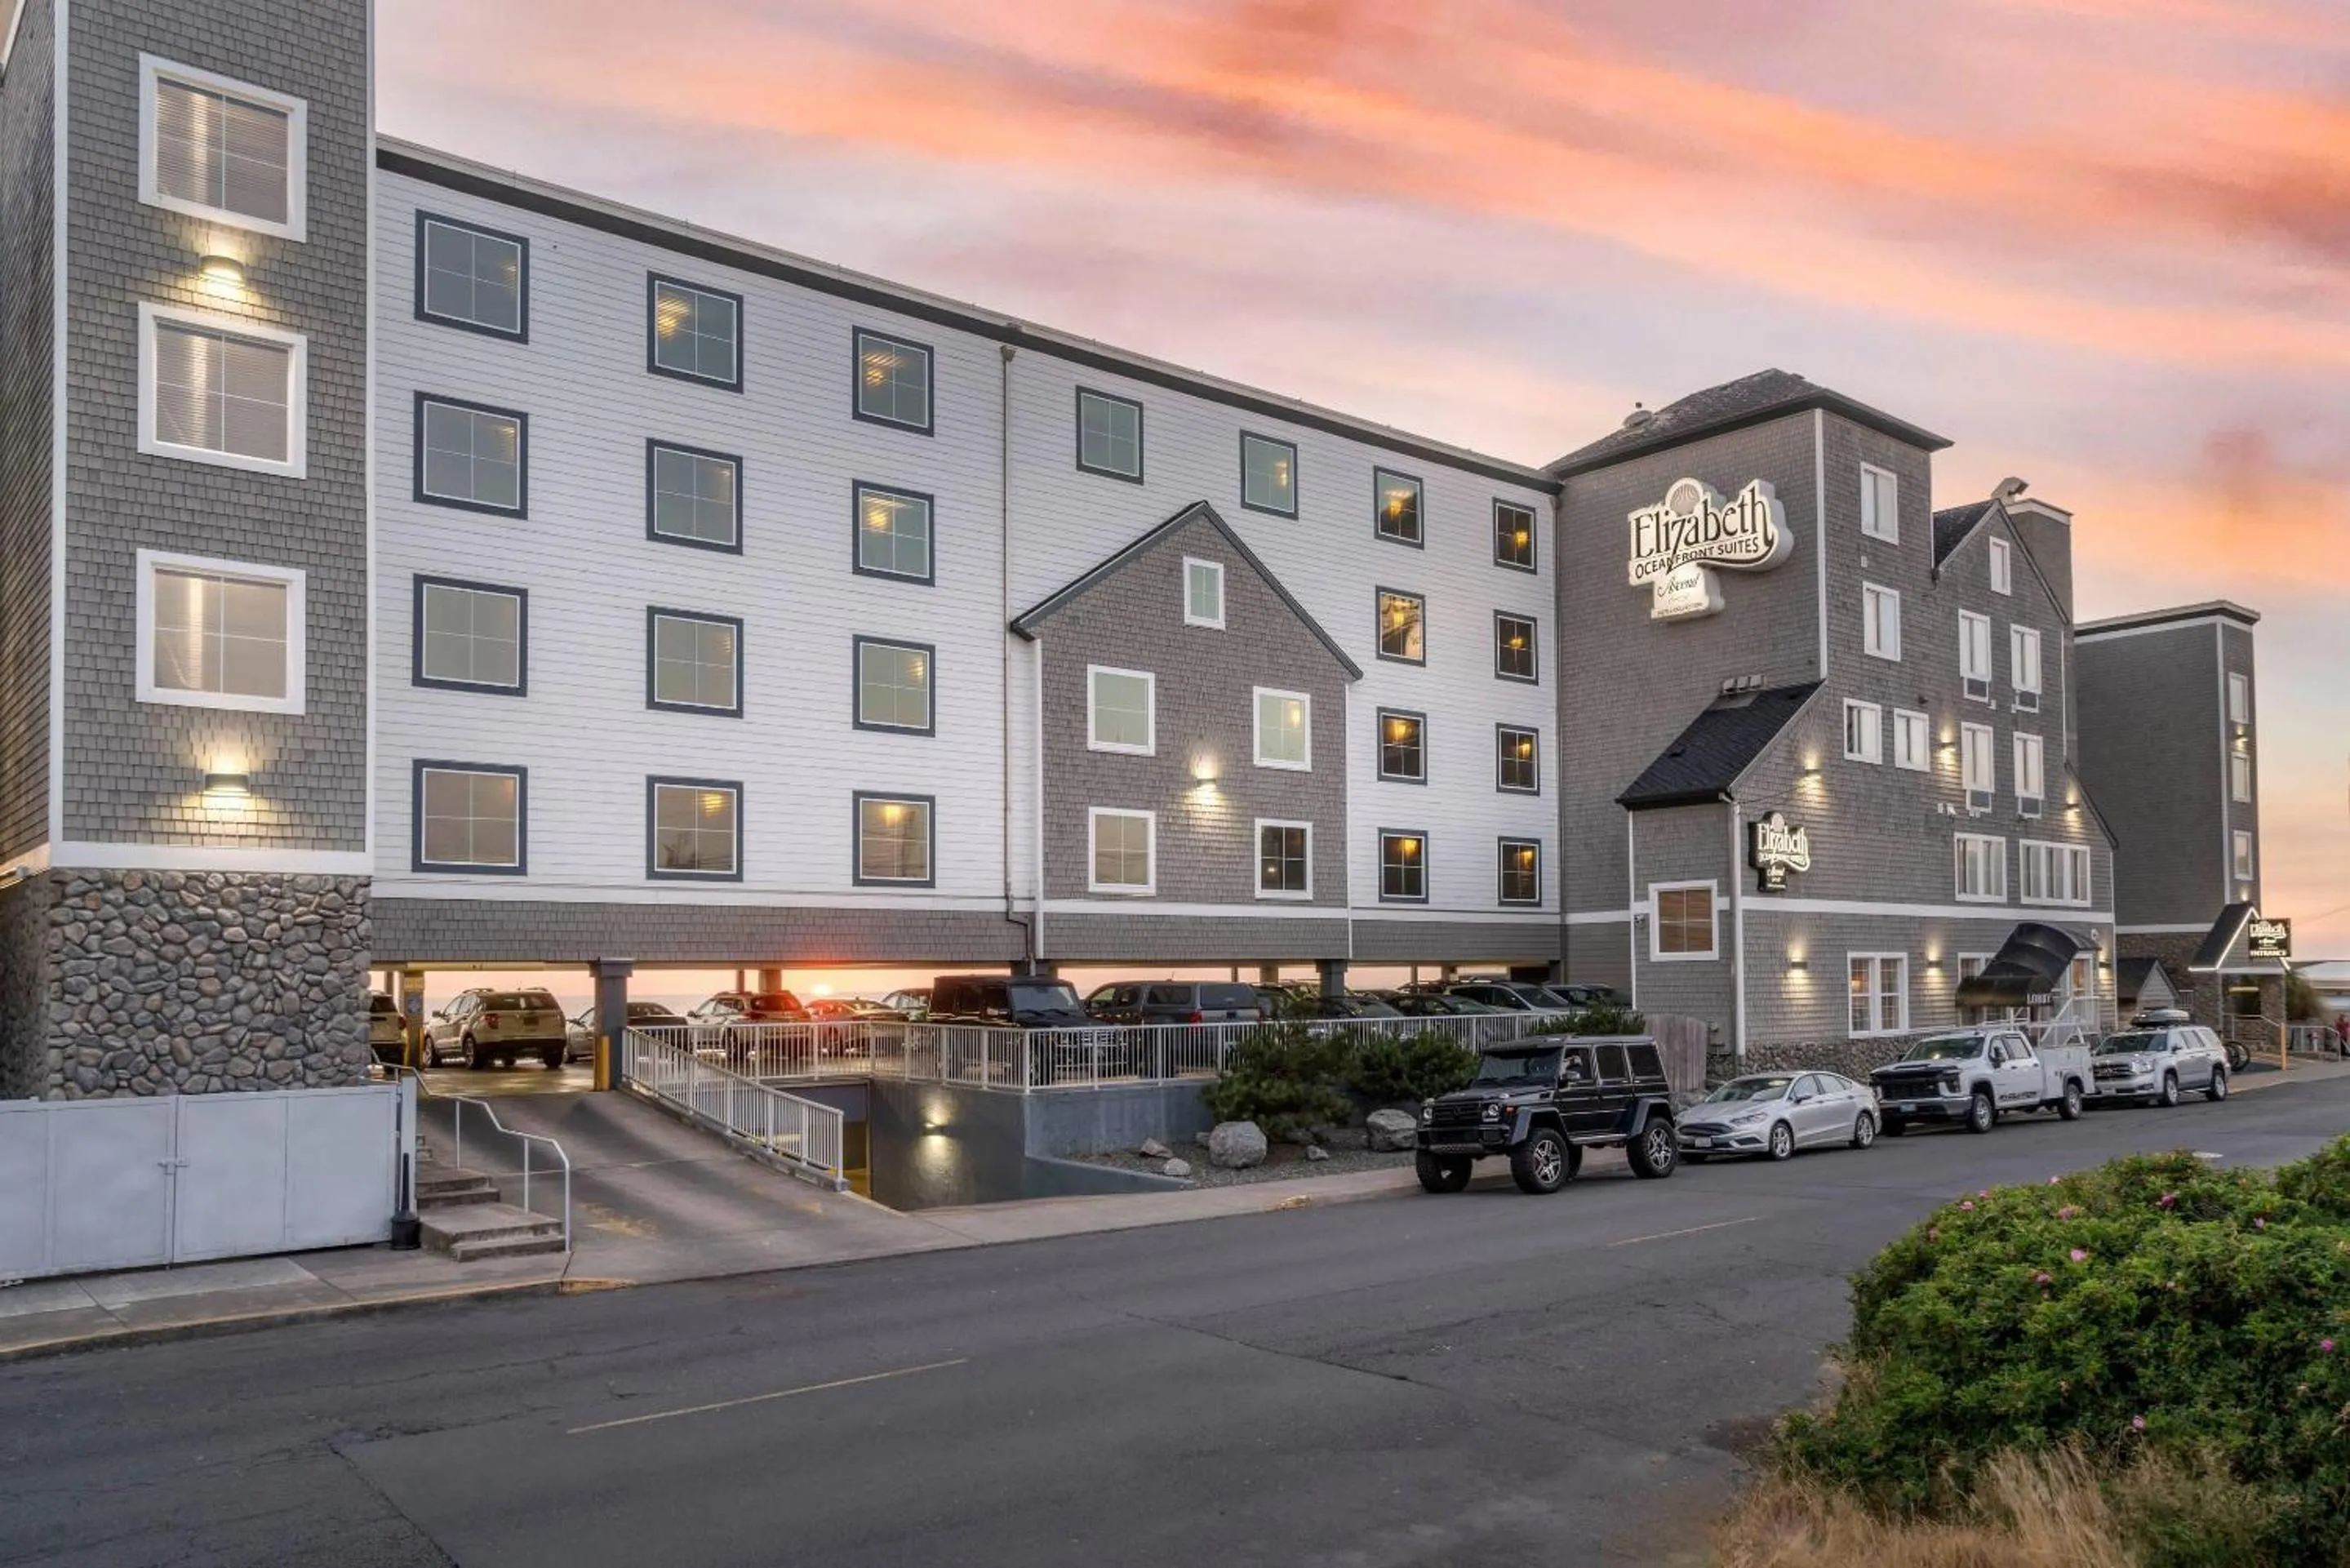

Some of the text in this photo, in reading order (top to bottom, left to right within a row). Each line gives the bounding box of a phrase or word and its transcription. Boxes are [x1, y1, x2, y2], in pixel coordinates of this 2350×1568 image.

[1634, 486, 1775, 574] Elizabeth
[1717, 536, 1759, 555] SUITES
[1757, 823, 1810, 865] Elizabeth
